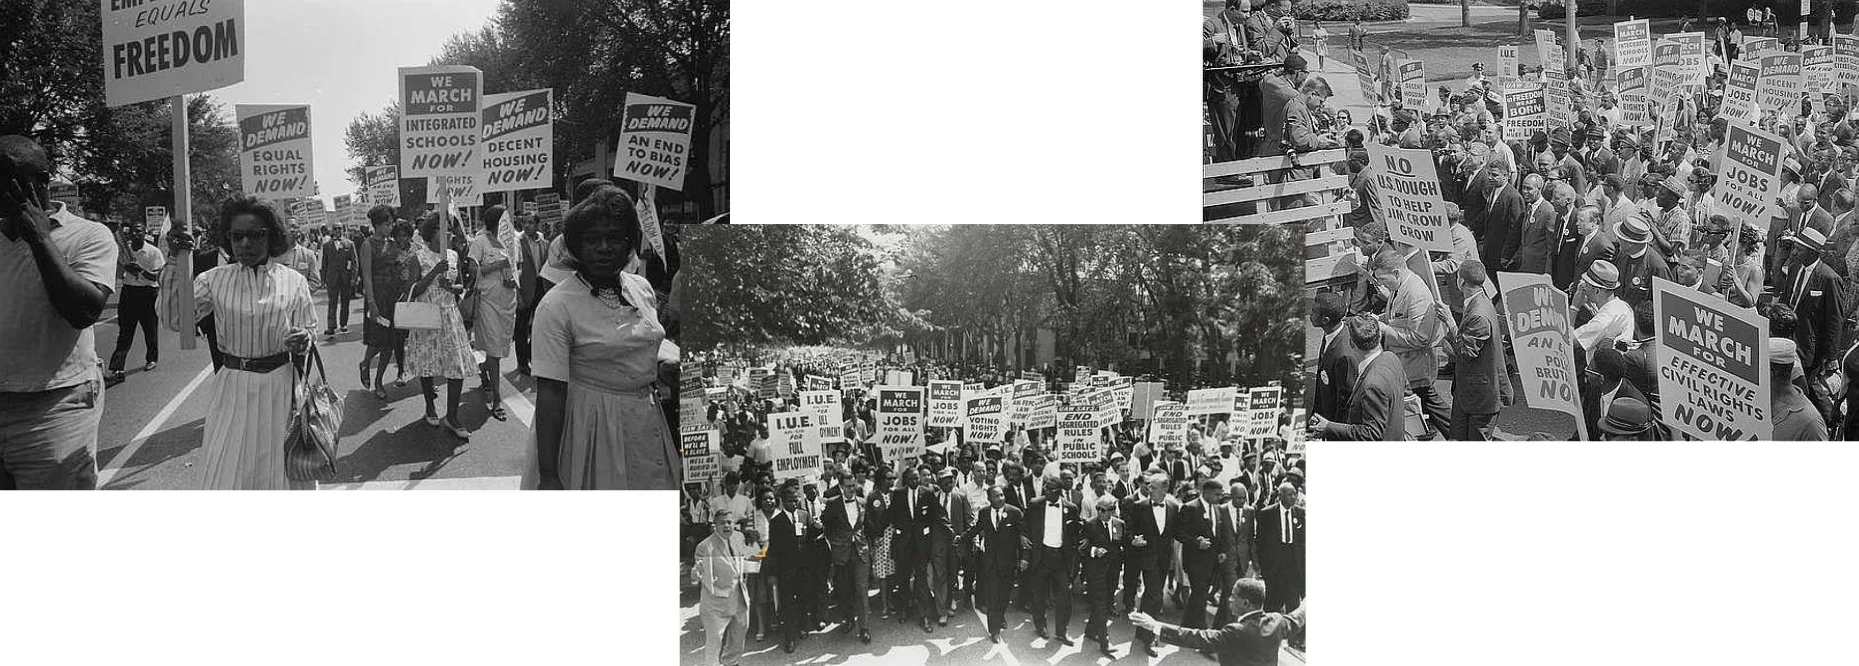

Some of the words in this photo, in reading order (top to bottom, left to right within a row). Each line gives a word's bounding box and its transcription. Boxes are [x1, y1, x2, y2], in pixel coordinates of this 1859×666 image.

[135, 0, 210, 28] EQUALS
[1619, 29, 1646, 38] MARCH
[113, 18, 238, 79] FREEDOM
[1618, 41, 1649, 49] INTEGRATED
[1619, 47, 1649, 56] SCHOOLS
[1663, 45, 1674, 55] WE
[1755, 41, 1767, 50] WE
[1814, 48, 1829, 57] WE
[1622, 55, 1649, 65] NOW!
[1774, 57, 1789, 66] WE
[1624, 70, 1635, 80] WE
[1763, 64, 1800, 76] DEMAND
[429, 76, 453, 88] WE
[1731, 73, 1756, 84] MARCH
[1766, 78, 1798, 89] DECENT
[410, 88, 472, 104] MARCH
[1513, 90, 1544, 103] FREEDOM
[1620, 94, 1646, 102] VOTING
[1728, 89, 1752, 102] JOBS
[1762, 88, 1800, 100] HOUSING
[429, 104, 454, 112] FOR
[500, 98, 526, 118] WE
[1622, 103, 1646, 111] RIGHTS
[1764, 97, 1798, 109] NOW!
[646, 105, 673, 117] WE
[1623, 112, 1647, 122] NOW!
[1723, 106, 1750, 120] NOW!
[262, 112, 287, 129] WE
[406, 117, 477, 132] INTEGRATED
[482, 107, 547, 139] DEMAND
[628, 117, 689, 130] DEMAND
[1506, 119, 1545, 128] FREEDOM
[246, 121, 306, 148] DEMAND
[1746, 134, 1763, 148] WE
[406, 134, 476, 149] SCHOOLS
[488, 137, 543, 153] DECENT
[628, 135, 650, 147] AN
[654, 139, 684, 154] END
[253, 149, 303, 162] EQUAL
[628, 147, 646, 158] TO
[650, 151, 681, 166] BIAS
[1731, 140, 1774, 166] MARCH
[411, 150, 473, 170] NOW!
[483, 153, 548, 169] HOUSING
[1385, 155, 1412, 174] NO
[1741, 157, 1759, 169] FOR
[253, 163, 305, 176] RIGHTS
[487, 164, 546, 186] NOW!
[625, 160, 680, 181] NOW!
[255, 175, 307, 194] NOW!
[436, 176, 473, 185] GHTS
[1726, 167, 1768, 193] JOBS
[434, 185, 473, 199] OW!
[1395, 178, 1438, 196] DOUGH
[1725, 181, 1743, 193] FOR
[1747, 190, 1764, 202] ALL
[1388, 195, 1401, 207] TO
[1402, 198, 1432, 213] HELP
[1721, 191, 1766, 219] NOW!
[1388, 207, 1406, 222] JIM
[1407, 213, 1442, 227] CROW
[1400, 225, 1433, 242] GROW
[1516, 307, 1568, 336] DEMD
[1694, 306, 1724, 333] WE
[1527, 336, 1554, 350] AN
[1668, 315, 1752, 367] MARCH
[1693, 346, 1727, 369] FOR
[1535, 366, 1568, 383] BRUT
[1671, 355, 1756, 402] EFFECTIVE
[894, 391, 907, 399] WE
[1539, 380, 1573, 402] NO
[1661, 366, 1700, 393] CIVIL
[1703, 384, 1764, 421] RIGHTS
[807, 394, 837, 405] I.U.E.
[883, 399, 918, 408] MARCH
[1252, 397, 1277, 405] MARCH
[933, 402, 959, 411] JOBS
[969, 404, 1001, 414] DEMAND
[1688, 391, 1735, 423] LAWS
[882, 416, 917, 426] JOBS
[932, 416, 959, 425] NOW!
[969, 416, 1000, 425] VOTING
[1011, 412, 1031, 420] NOW!
[1065, 412, 1092, 421] END
[1251, 411, 1275, 420] JOBS
[776, 415, 814, 431] I.U.E.
[970, 424, 998, 432] RIGHTS
[1058, 420, 1099, 429] SEGREGATED
[819, 426, 841, 438] OYMENT
[969, 431, 999, 440] NOW!
[1064, 428, 1093, 437] RULES
[1249, 425, 1275, 435] NOW!
[882, 433, 919, 445] NOW!
[1158, 434, 1184, 442] PUBLIC
[788, 441, 804, 455] FULL
[1063, 443, 1096, 451] PUBLIC
[1061, 450, 1098, 460] SCHOOLS
[776, 454, 820, 471] EMPLOYMENT
